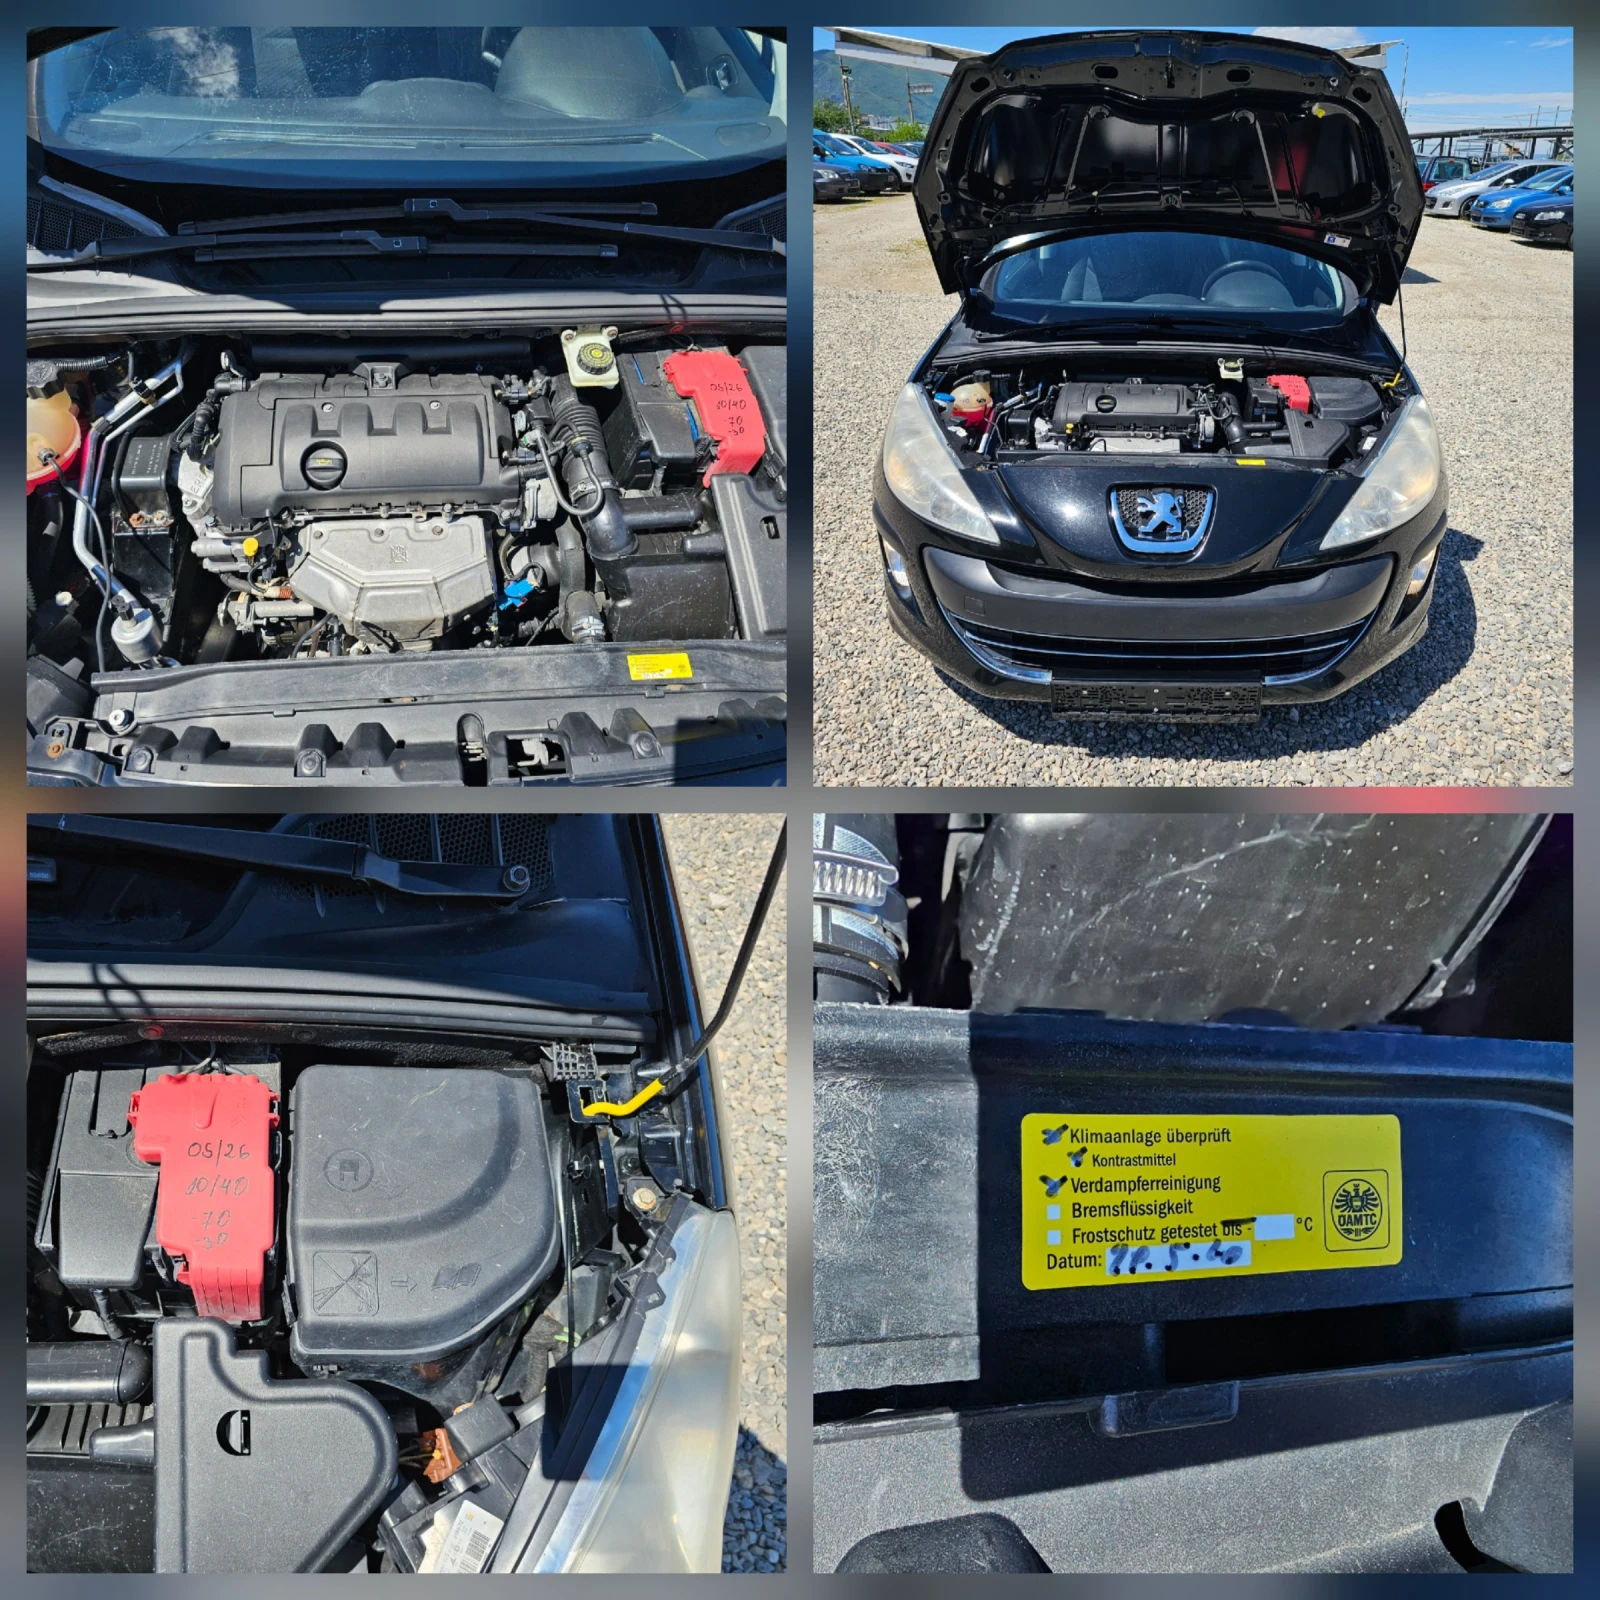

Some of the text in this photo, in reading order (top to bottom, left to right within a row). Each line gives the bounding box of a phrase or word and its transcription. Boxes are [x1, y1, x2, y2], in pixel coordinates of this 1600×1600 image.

[1070, 1127, 1232, 1147] Klimaanlage überprüft
[187, 1139, 250, 1168] 05/26
[1092, 1153, 1176, 1168] Kontrastmittel
[185, 1174, 249, 1198] 10/40
[1070, 1174, 1221, 1195] Verdampferreinigung
[1072, 1198, 1194, 1218] Bremsflüssigkeit
[1072, 1226, 1156, 1244] Frostschutz
[1160, 1223, 1218, 1244] getestet
[1222, 1220, 1242, 1236] bis
[1047, 1253, 1102, 1270] Datum:
